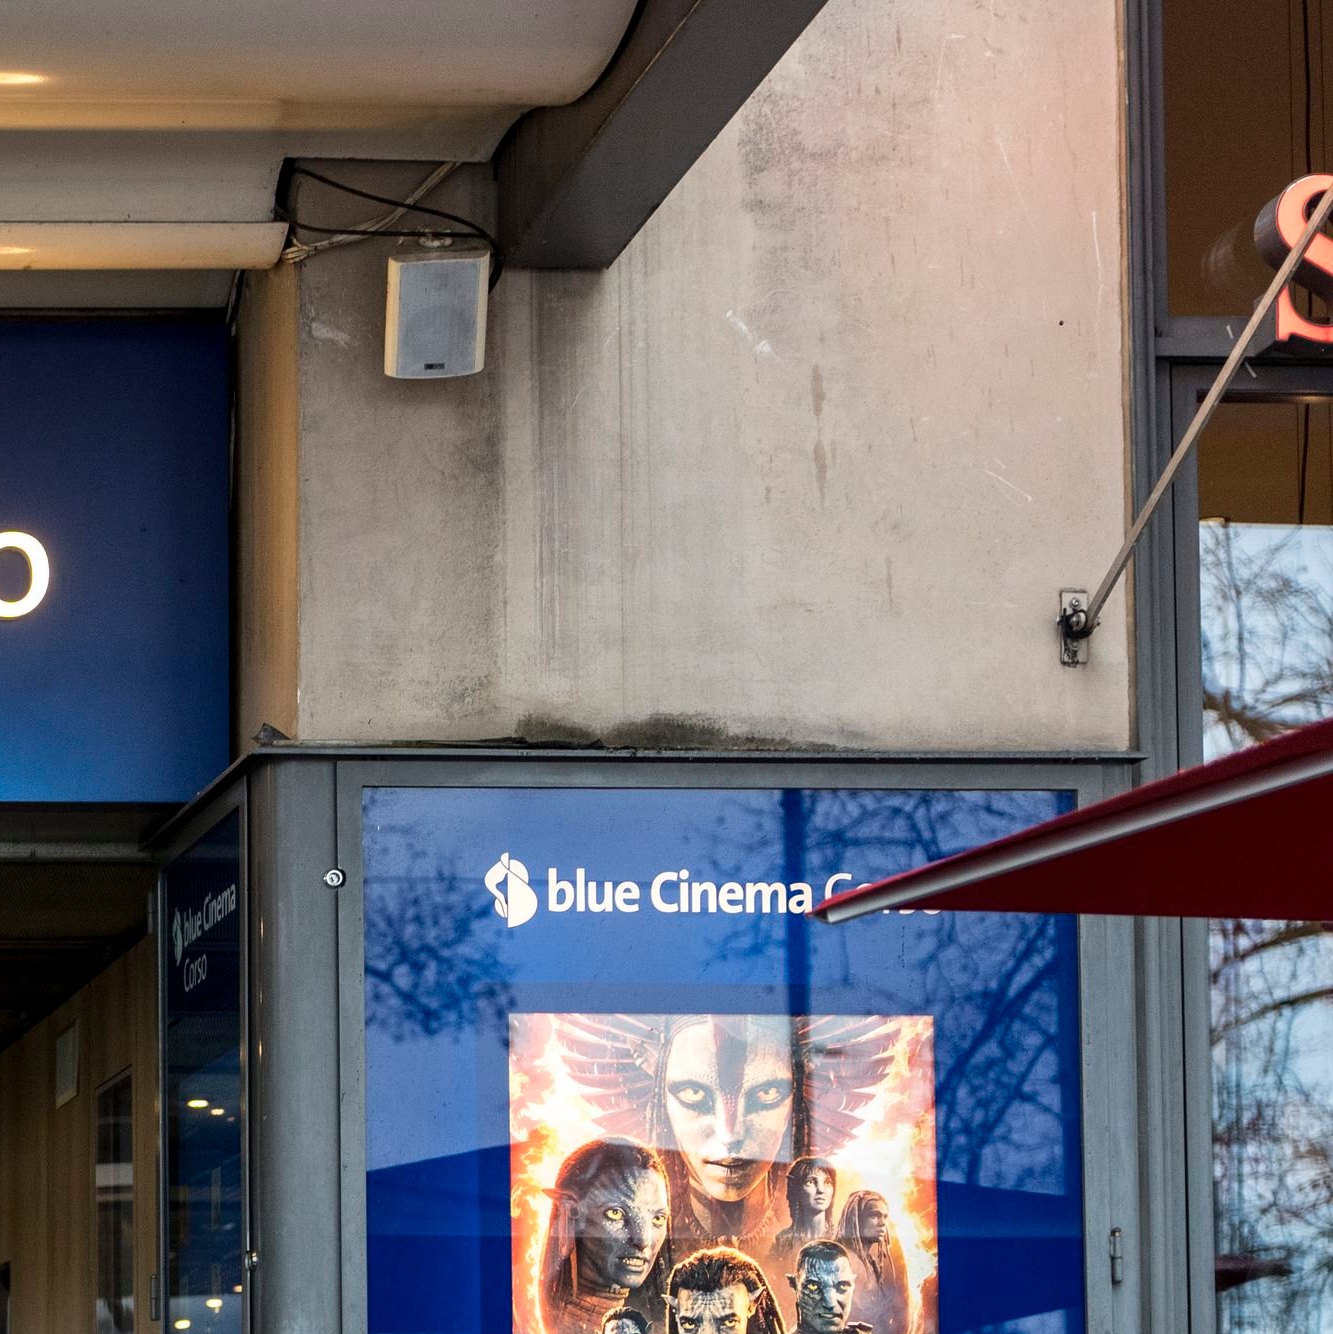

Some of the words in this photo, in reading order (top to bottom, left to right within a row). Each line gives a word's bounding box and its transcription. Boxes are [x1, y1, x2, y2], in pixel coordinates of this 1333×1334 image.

[547, 867, 640, 913] blue
[650, 869, 813, 914] Cinema
[184, 907, 202, 948] blue
[203, 883, 236, 931] Cinema
[184, 954, 207, 992] Corso
